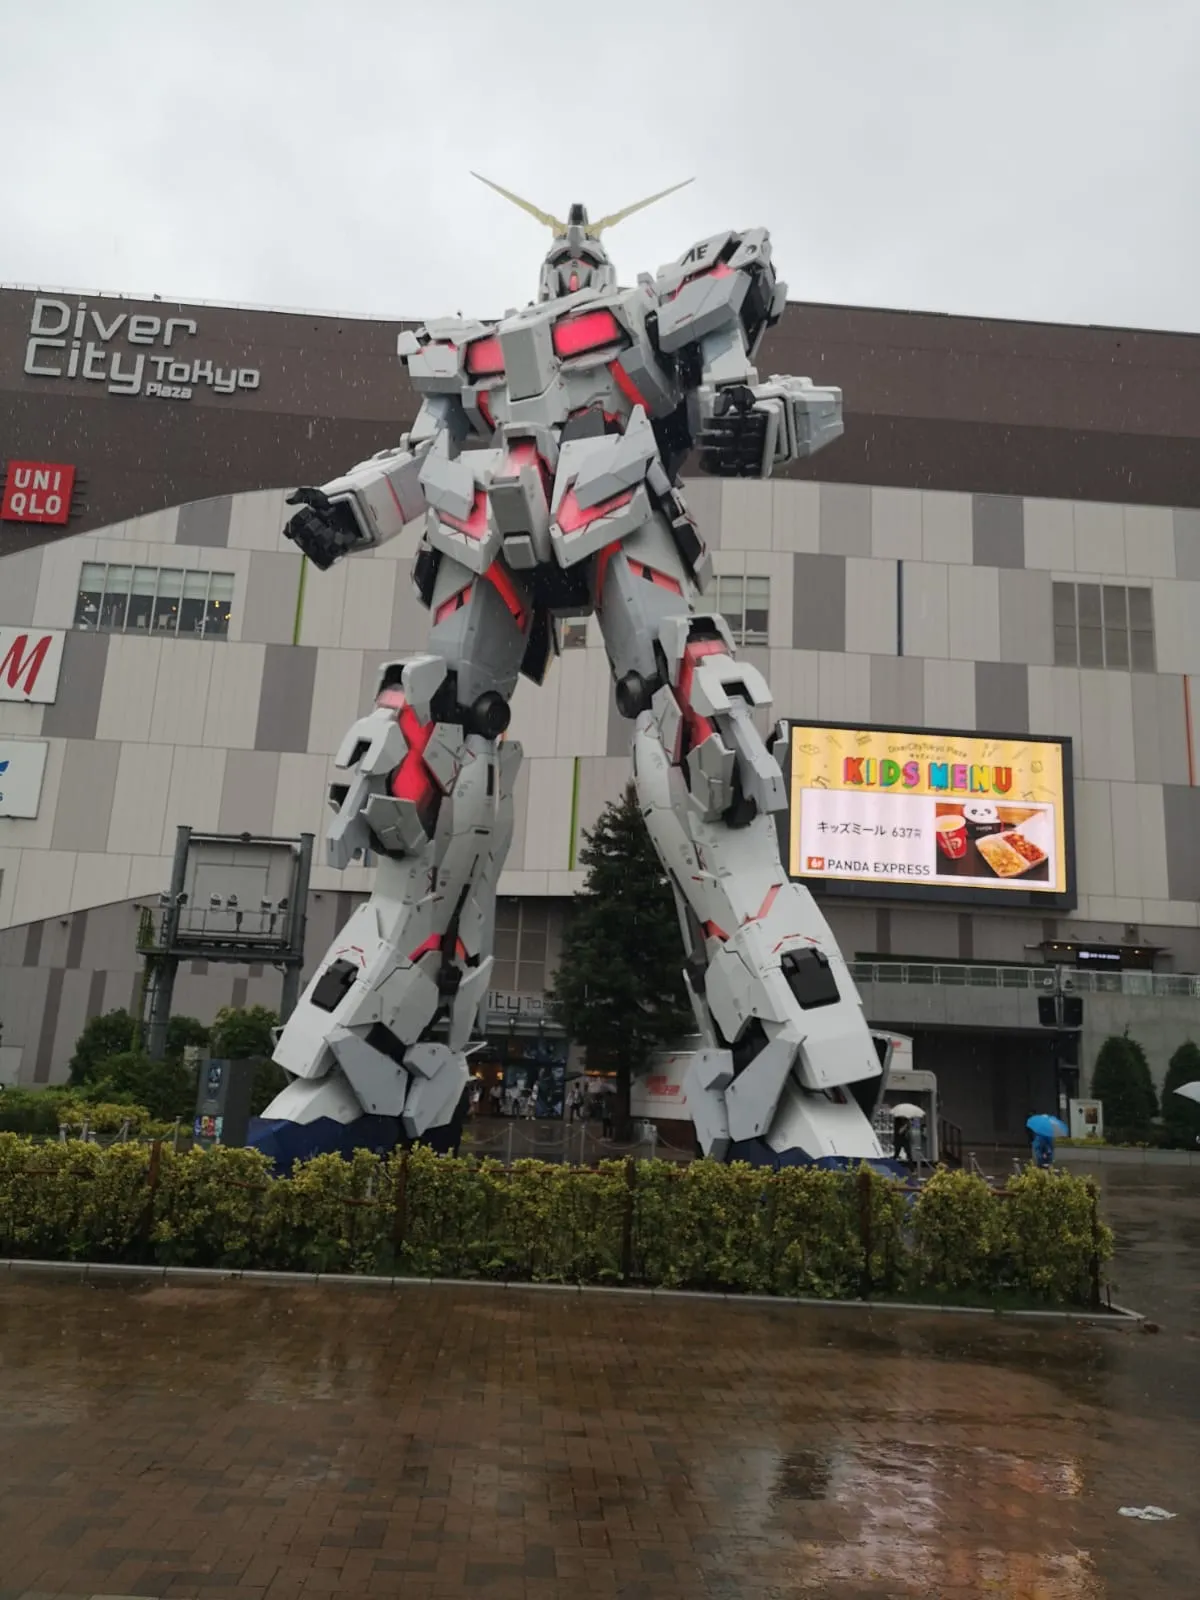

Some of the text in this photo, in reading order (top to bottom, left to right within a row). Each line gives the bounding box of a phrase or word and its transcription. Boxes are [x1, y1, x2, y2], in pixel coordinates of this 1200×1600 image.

[30, 298, 197, 346] Diver
[24, 337, 145, 395] City
[145, 382, 193, 400] Plaza
[14, 467, 61, 490] UNI
[10, 492, 62, 516] QLO
[842, 756, 1013, 795] KIDS MENU
[817, 821, 887, 836] キッズミール
[827, 859, 870, 872] PANDA
[874, 862, 931, 876] EXPRESS
